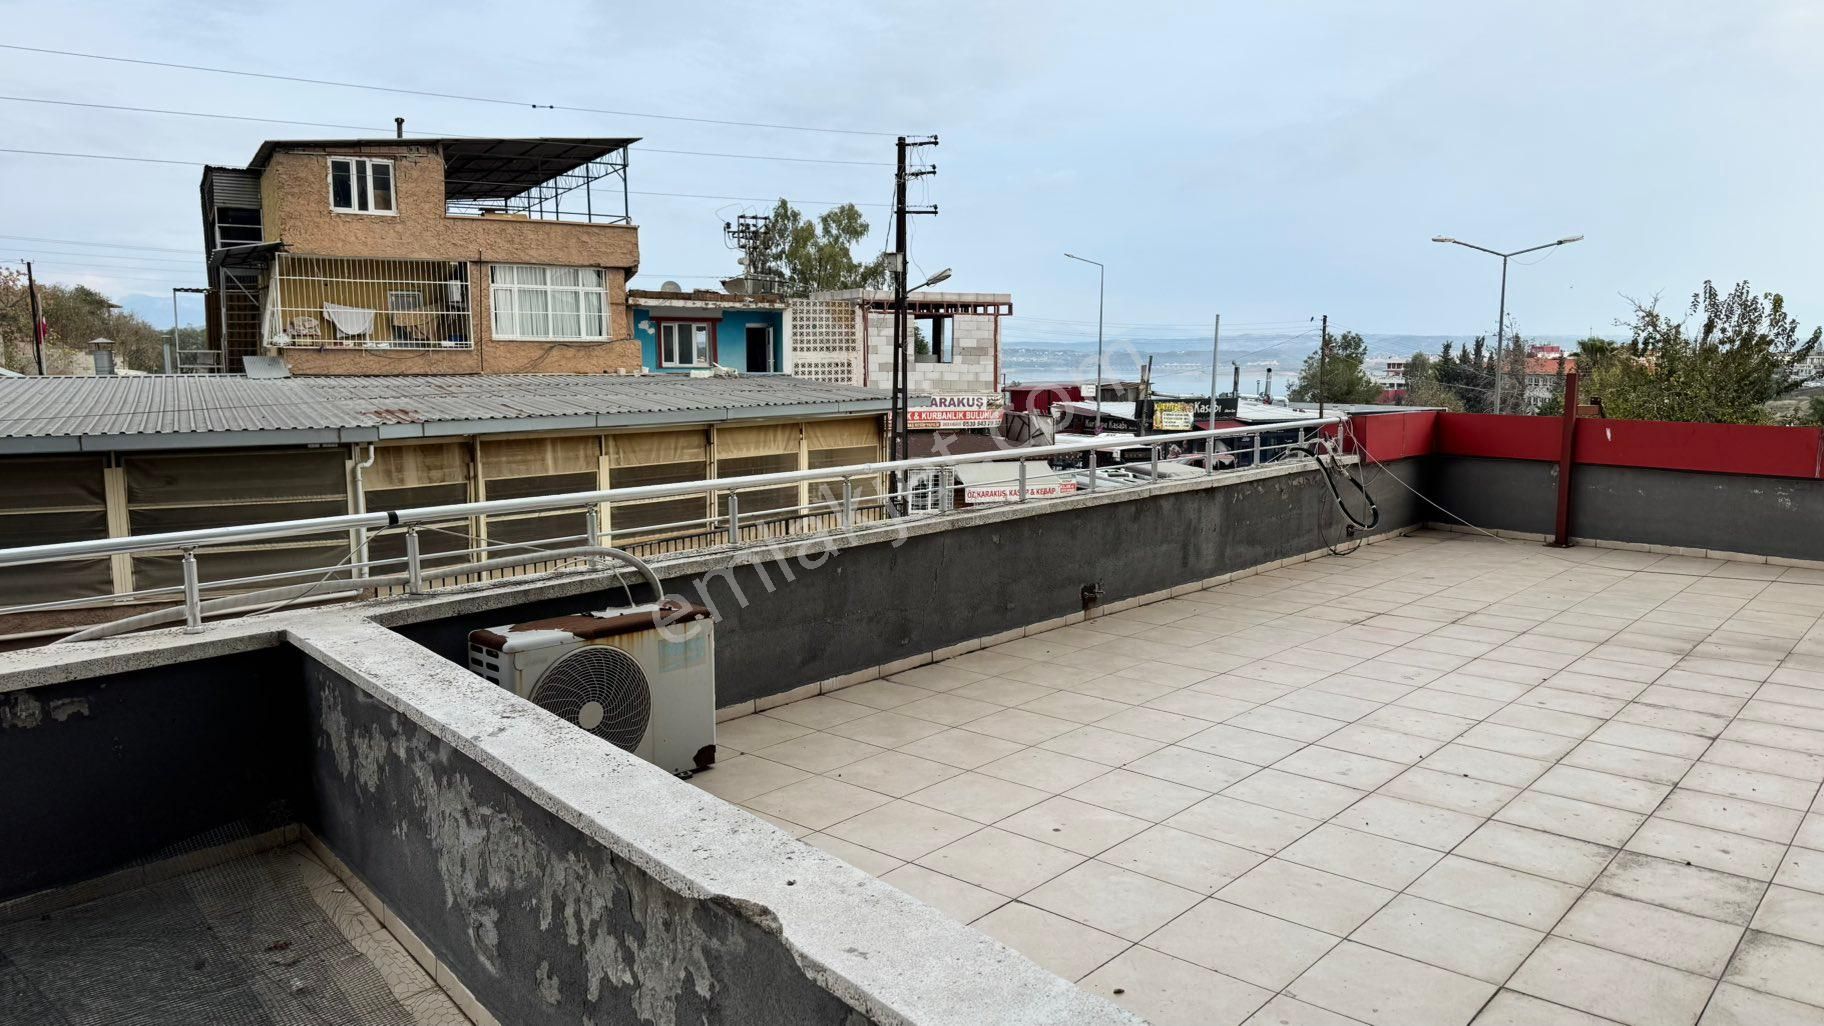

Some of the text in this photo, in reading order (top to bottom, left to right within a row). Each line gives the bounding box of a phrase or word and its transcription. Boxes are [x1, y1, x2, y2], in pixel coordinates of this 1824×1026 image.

[920, 397, 984, 410] ARAKUŞ
[1194, 401, 1222, 414] Kasbı
[922, 411, 964, 420] KURBANLIK
[1009, 488, 1029, 497] KASP
[1036, 487, 1056, 496] KEBAP
